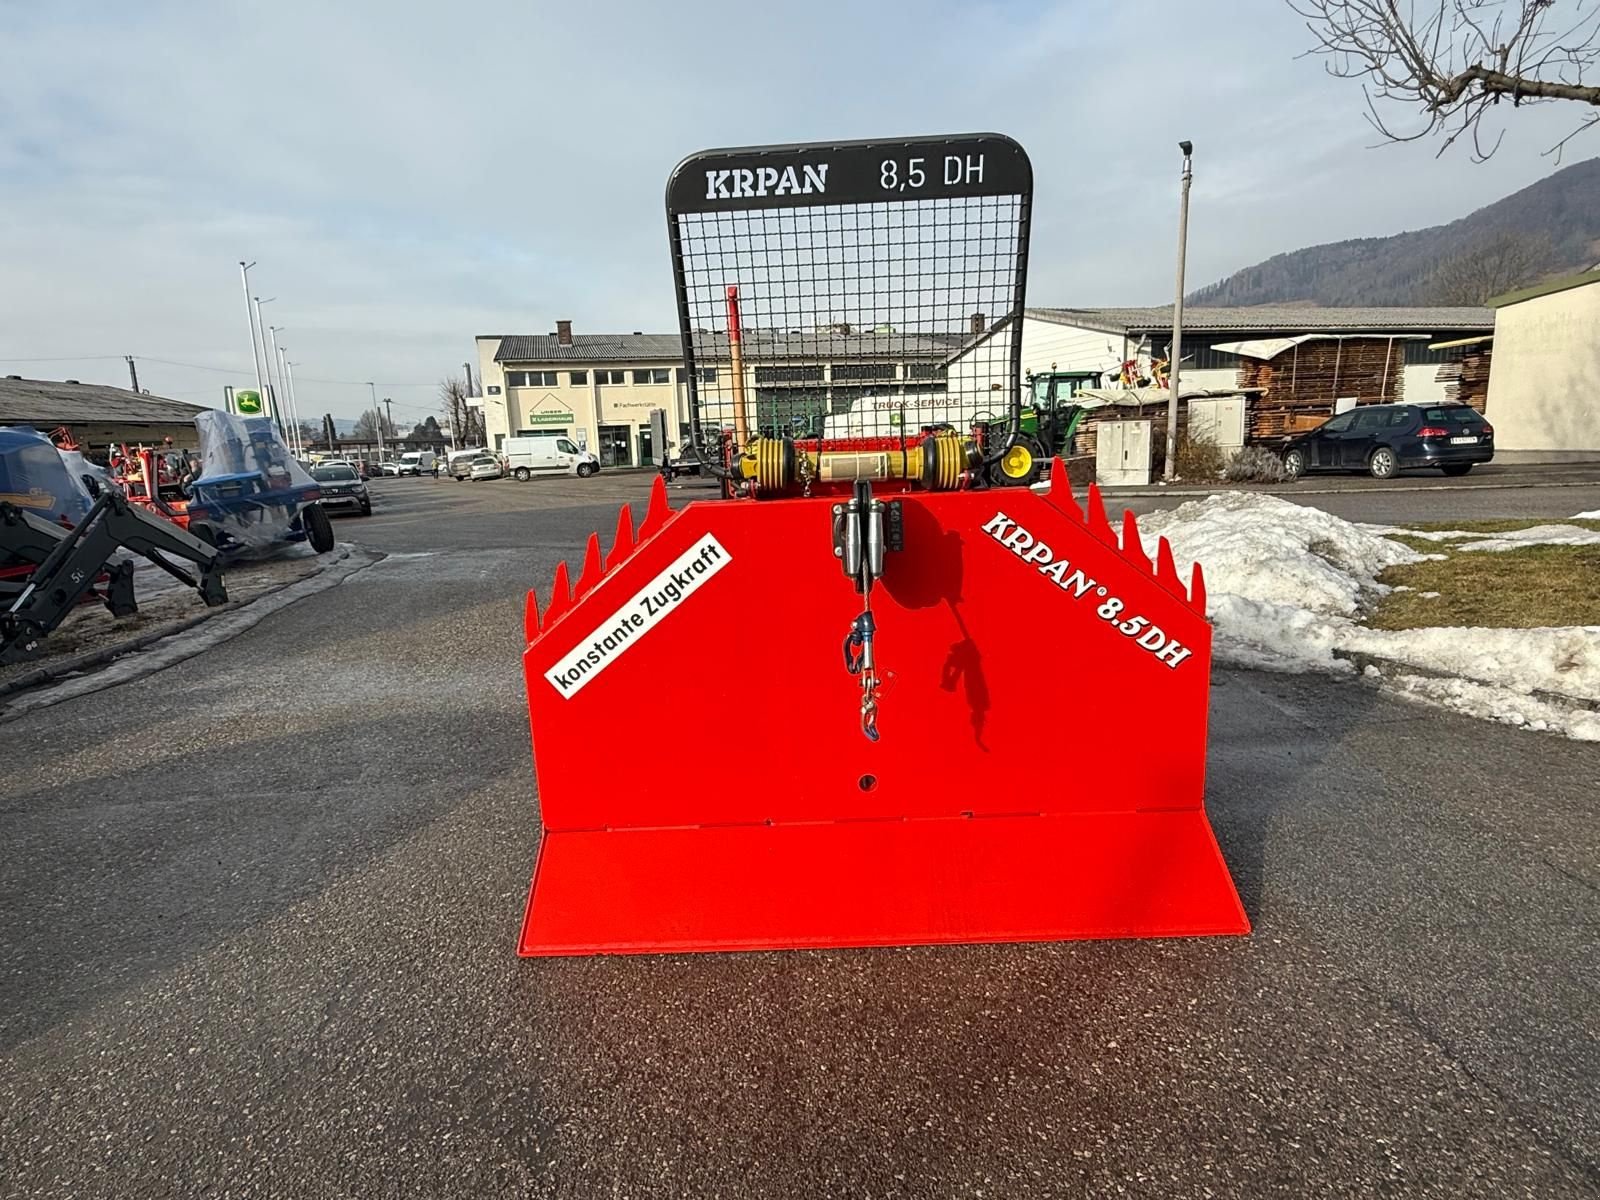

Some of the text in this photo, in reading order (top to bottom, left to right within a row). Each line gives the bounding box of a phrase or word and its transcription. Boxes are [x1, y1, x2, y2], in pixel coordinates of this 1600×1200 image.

[706, 154, 984, 200] KRPAN 8,5 DH
[872, 398, 960, 410] TRUCK-SERVICE
[553, 544, 721, 690] konstante Zugkraft
[1096, 597, 1192, 669] 8.5DH
